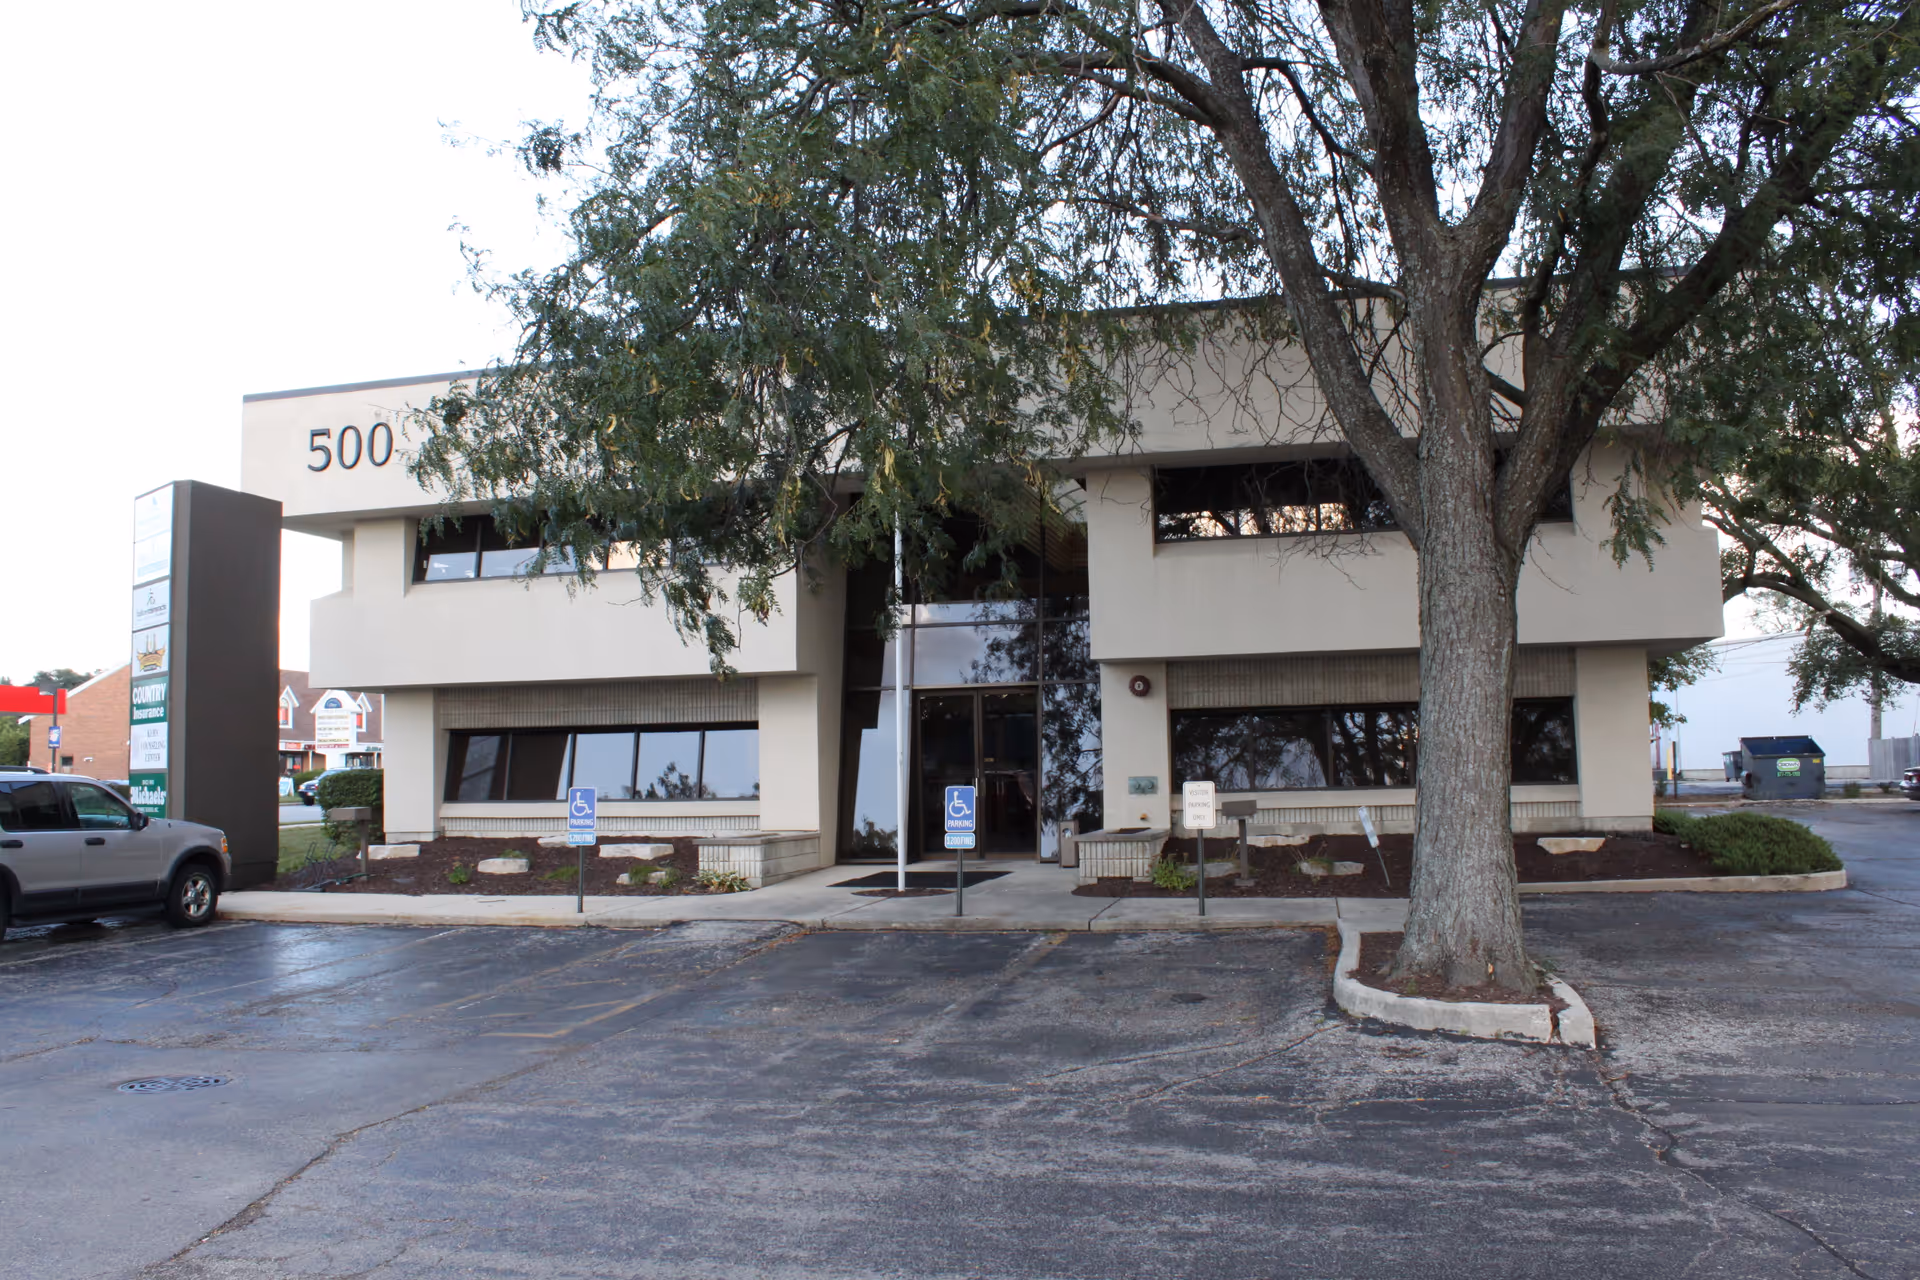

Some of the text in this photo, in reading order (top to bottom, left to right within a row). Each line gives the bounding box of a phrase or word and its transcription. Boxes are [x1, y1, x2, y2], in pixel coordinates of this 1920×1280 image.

[307, 421, 393, 472] 500
[132, 683, 166, 704] COUNTRY
[133, 706, 164, 720] Insurance
[570, 818, 594, 826] PARKING
[947, 819, 973, 828] PARKING
[961, 836, 973, 845] FINE
